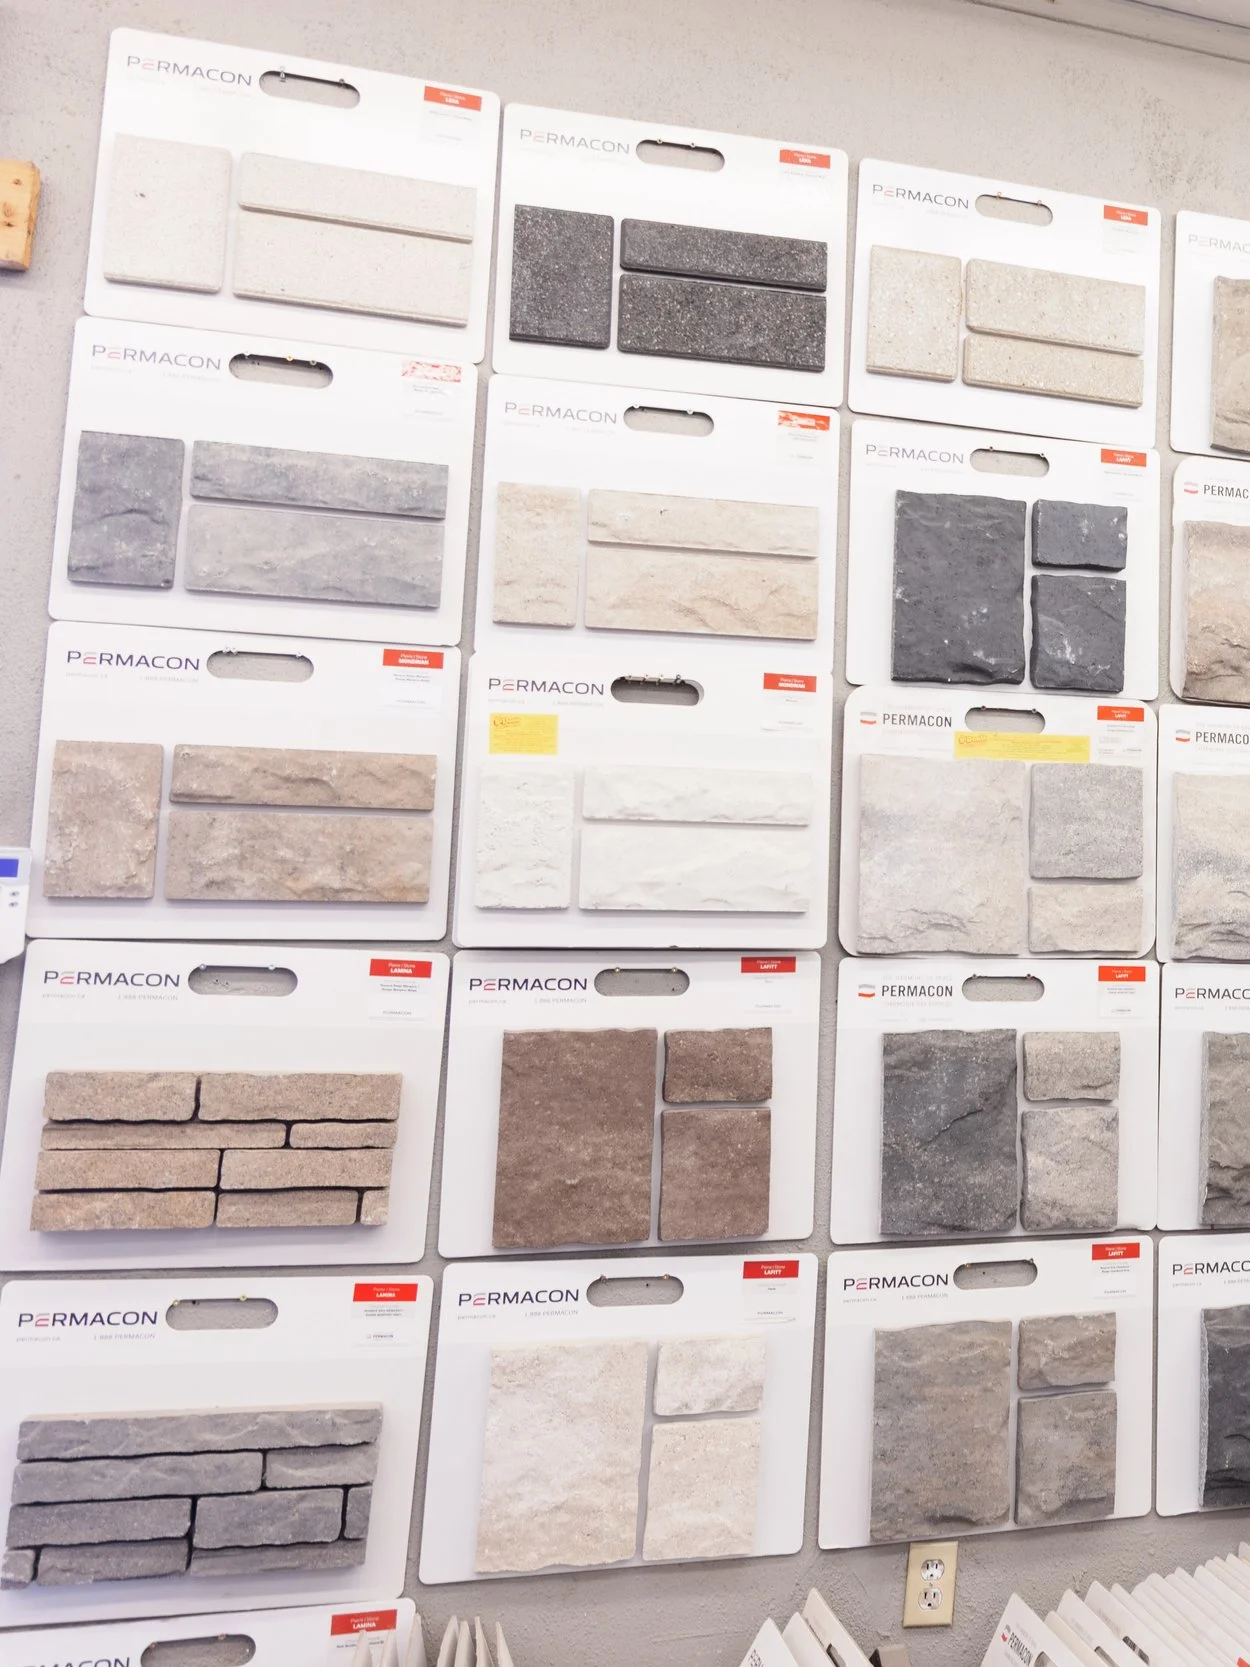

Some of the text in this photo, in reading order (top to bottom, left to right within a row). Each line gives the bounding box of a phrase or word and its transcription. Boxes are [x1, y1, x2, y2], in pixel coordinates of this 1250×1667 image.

[126, 55, 252, 86] PERMACON
[519, 128, 630, 155] PERMACON
[872, 183, 969, 210] PERMACON
[91, 344, 221, 371] PERMACON
[504, 401, 617, 424] PERMACON
[865, 443, 964, 464] PERMACON
[66, 650, 200, 671] PERMACON
[488, 677, 605, 696] PERMACON
[882, 712, 952, 728] PERMACON
[43, 970, 181, 988] PERMACON
[469, 977, 588, 992] PERMACON
[881, 984, 954, 998] PERMACON
[764, 1268, 782, 1276] LAFITT
[843, 1273, 949, 1291] PERMACON
[457, 1288, 580, 1307] PERMACON
[18, 1311, 158, 1328] PERMACON
